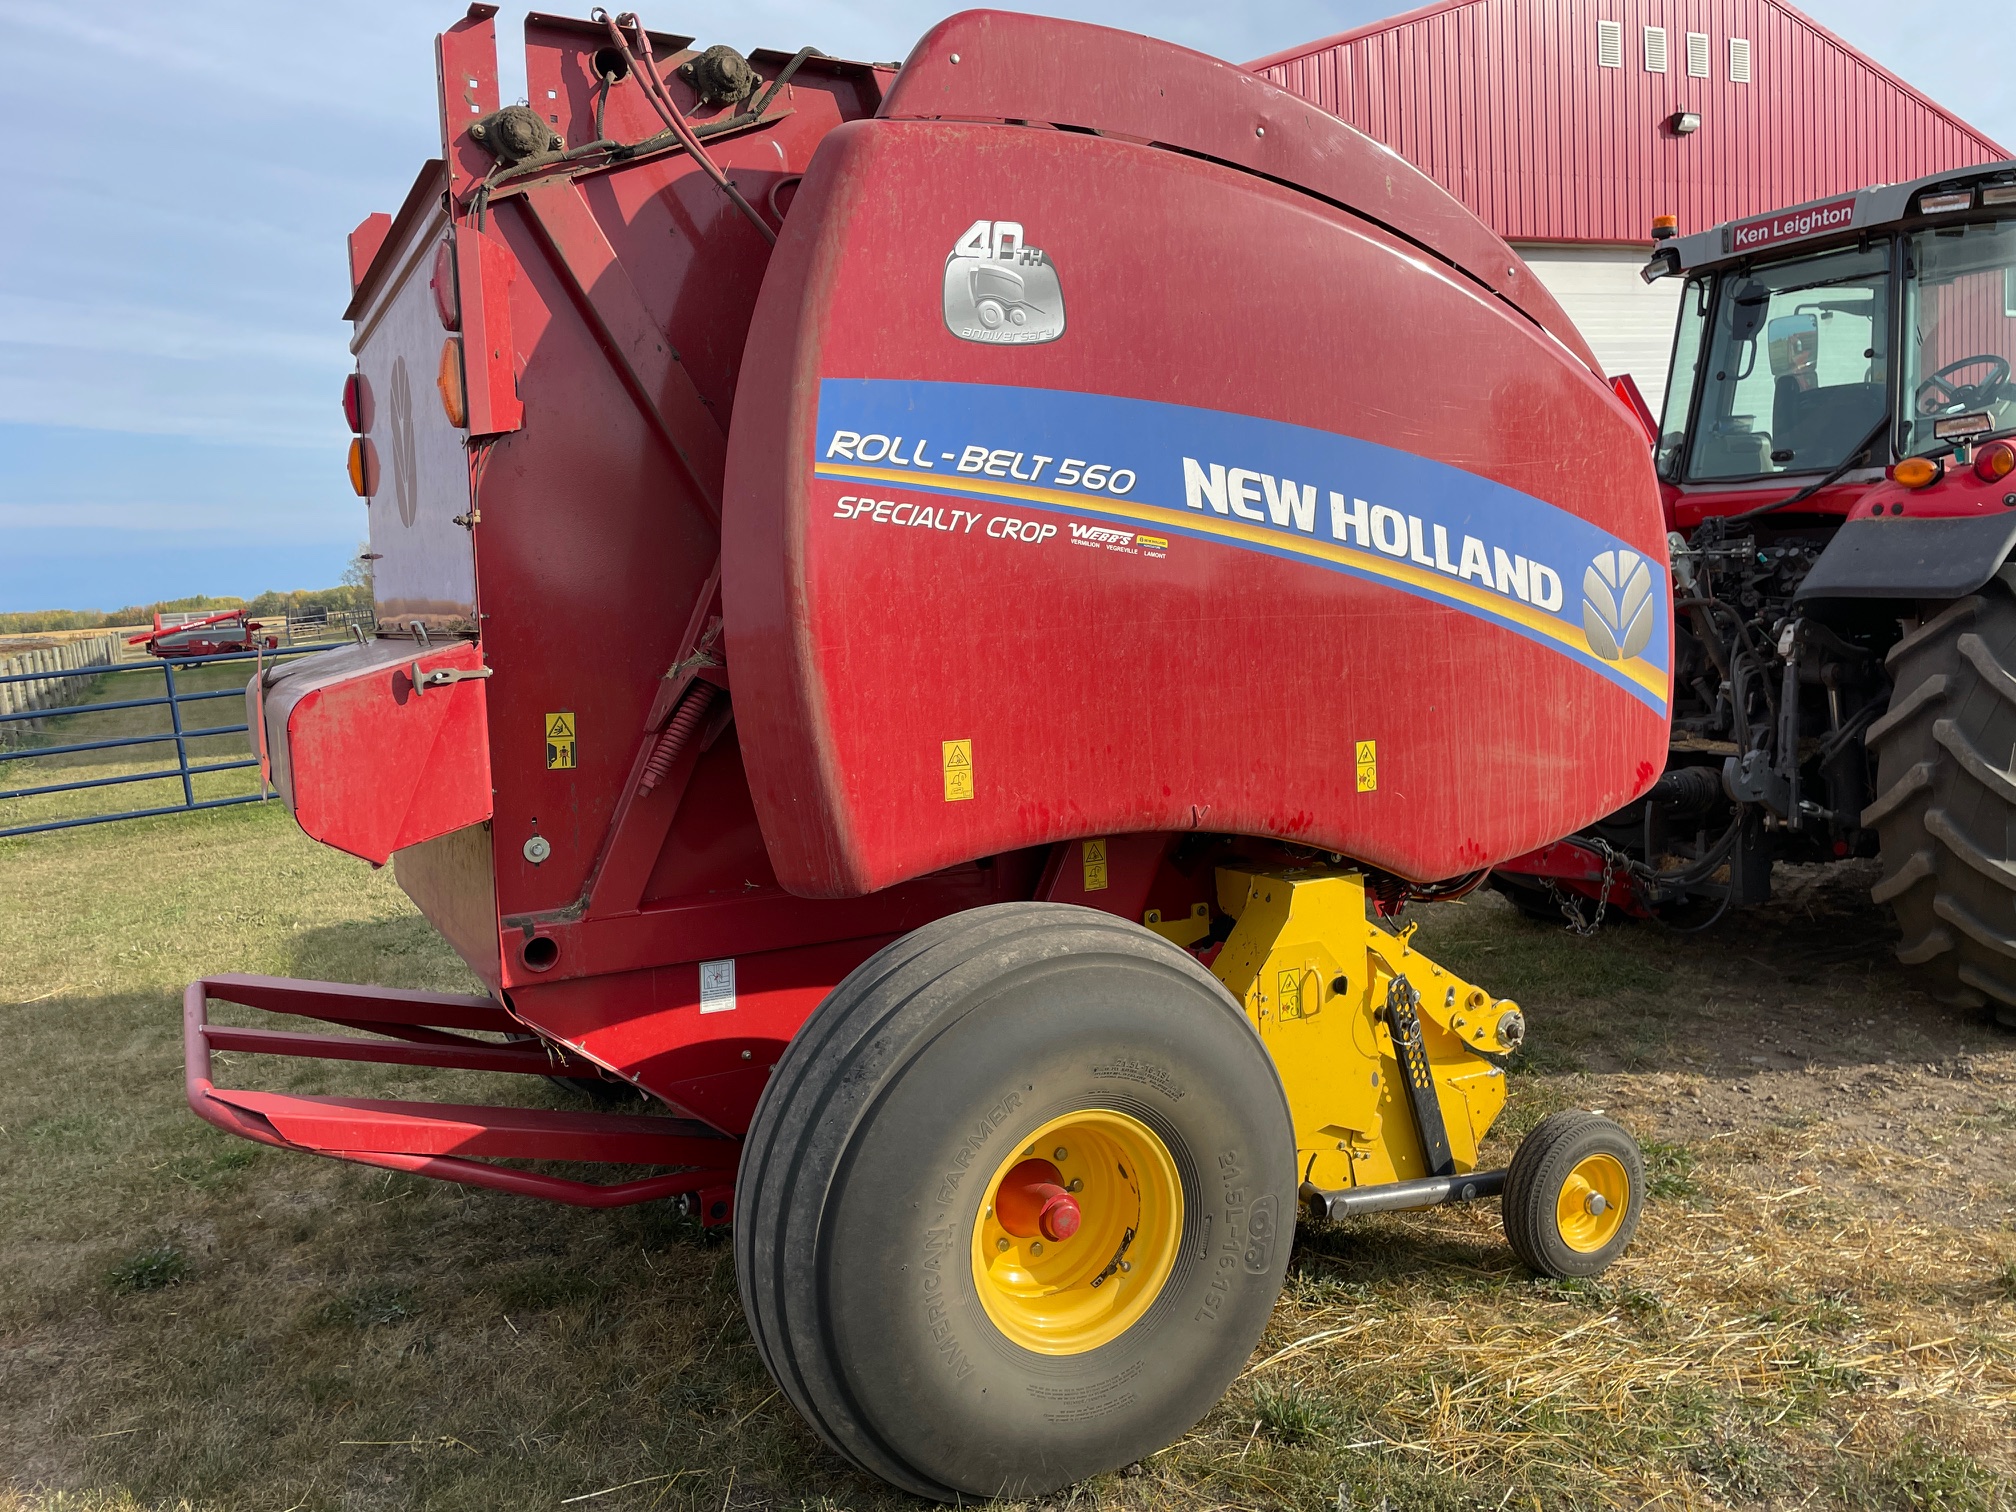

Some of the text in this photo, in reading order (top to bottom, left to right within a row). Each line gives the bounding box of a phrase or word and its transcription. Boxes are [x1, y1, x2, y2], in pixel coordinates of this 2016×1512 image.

[1736, 207, 1852, 246] Ken Leighton
[961, 327, 1055, 342] anniversary
[1054, 463, 1137, 495] 560
[833, 495, 1058, 545] SPECIALTY CROP
[1068, 522, 1135, 546] WEBB'S
[1182, 456, 1563, 613] NEW HOLLAND
[1070, 538, 1166, 559] VERMILION VEGREVILLE LAMONT
[924, 1091, 1023, 1379] AMERICAN FARMER
